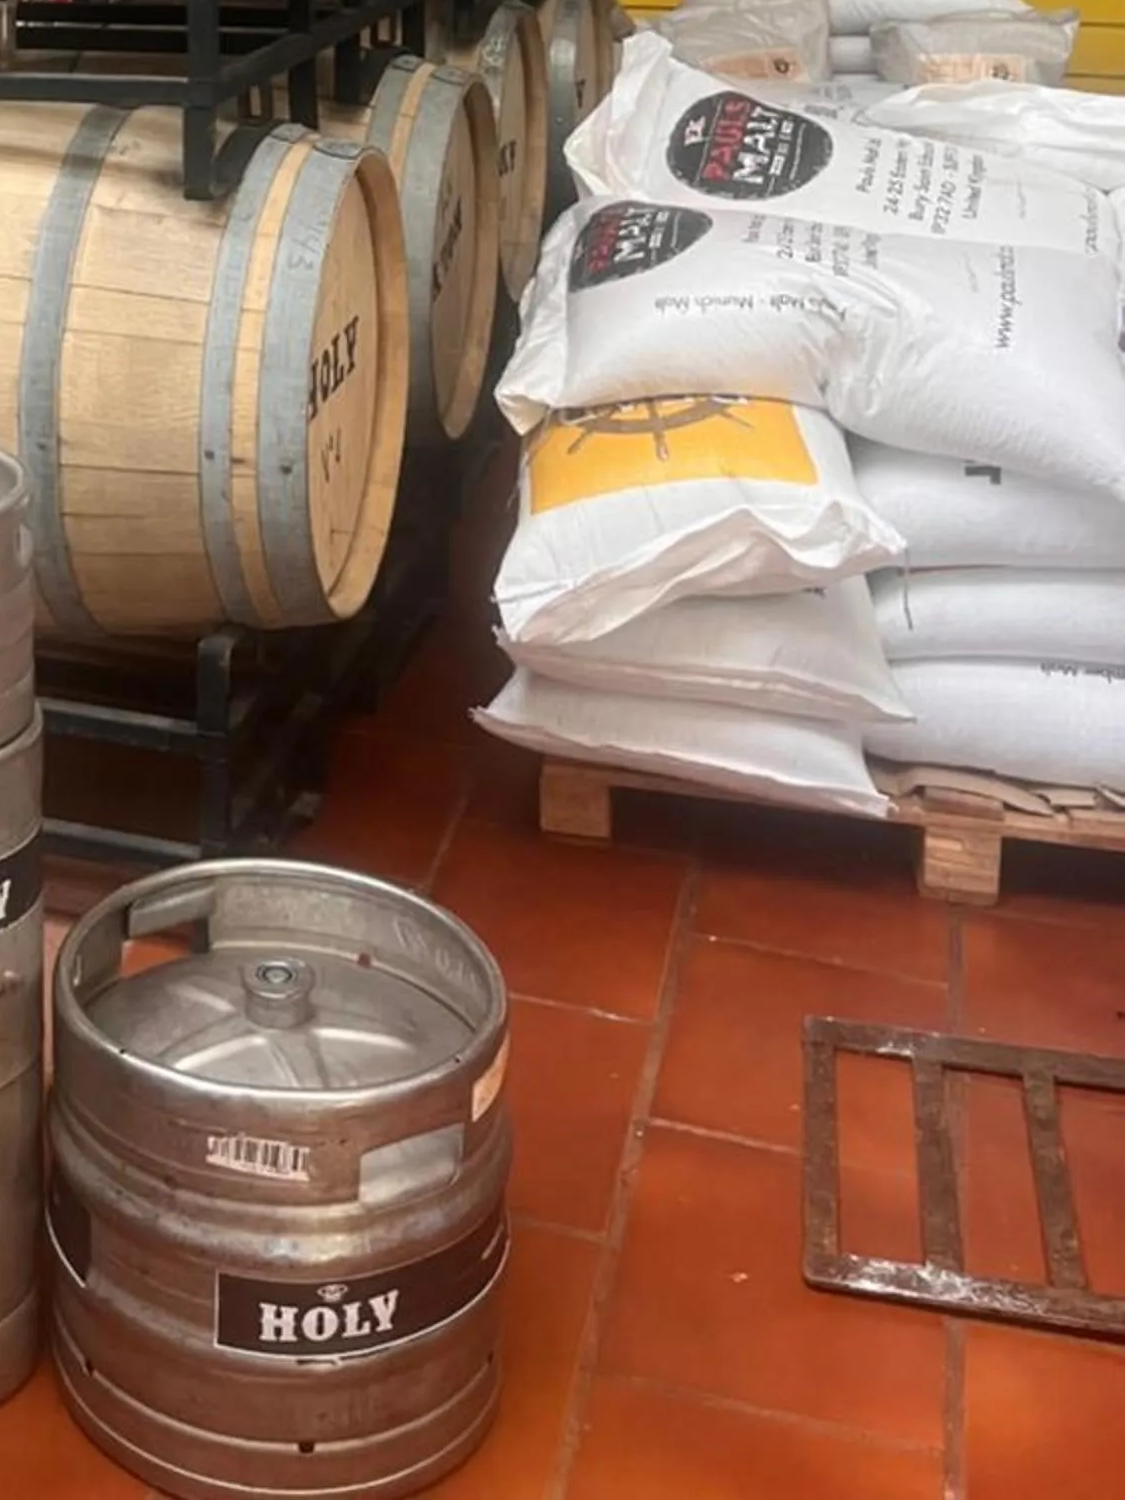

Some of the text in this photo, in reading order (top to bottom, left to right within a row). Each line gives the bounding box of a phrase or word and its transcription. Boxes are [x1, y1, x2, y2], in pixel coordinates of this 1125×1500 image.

[702, 100, 751, 181] PAULS
[732, 106, 779, 184] MALT
[259, 1288, 399, 1342] HOLY
